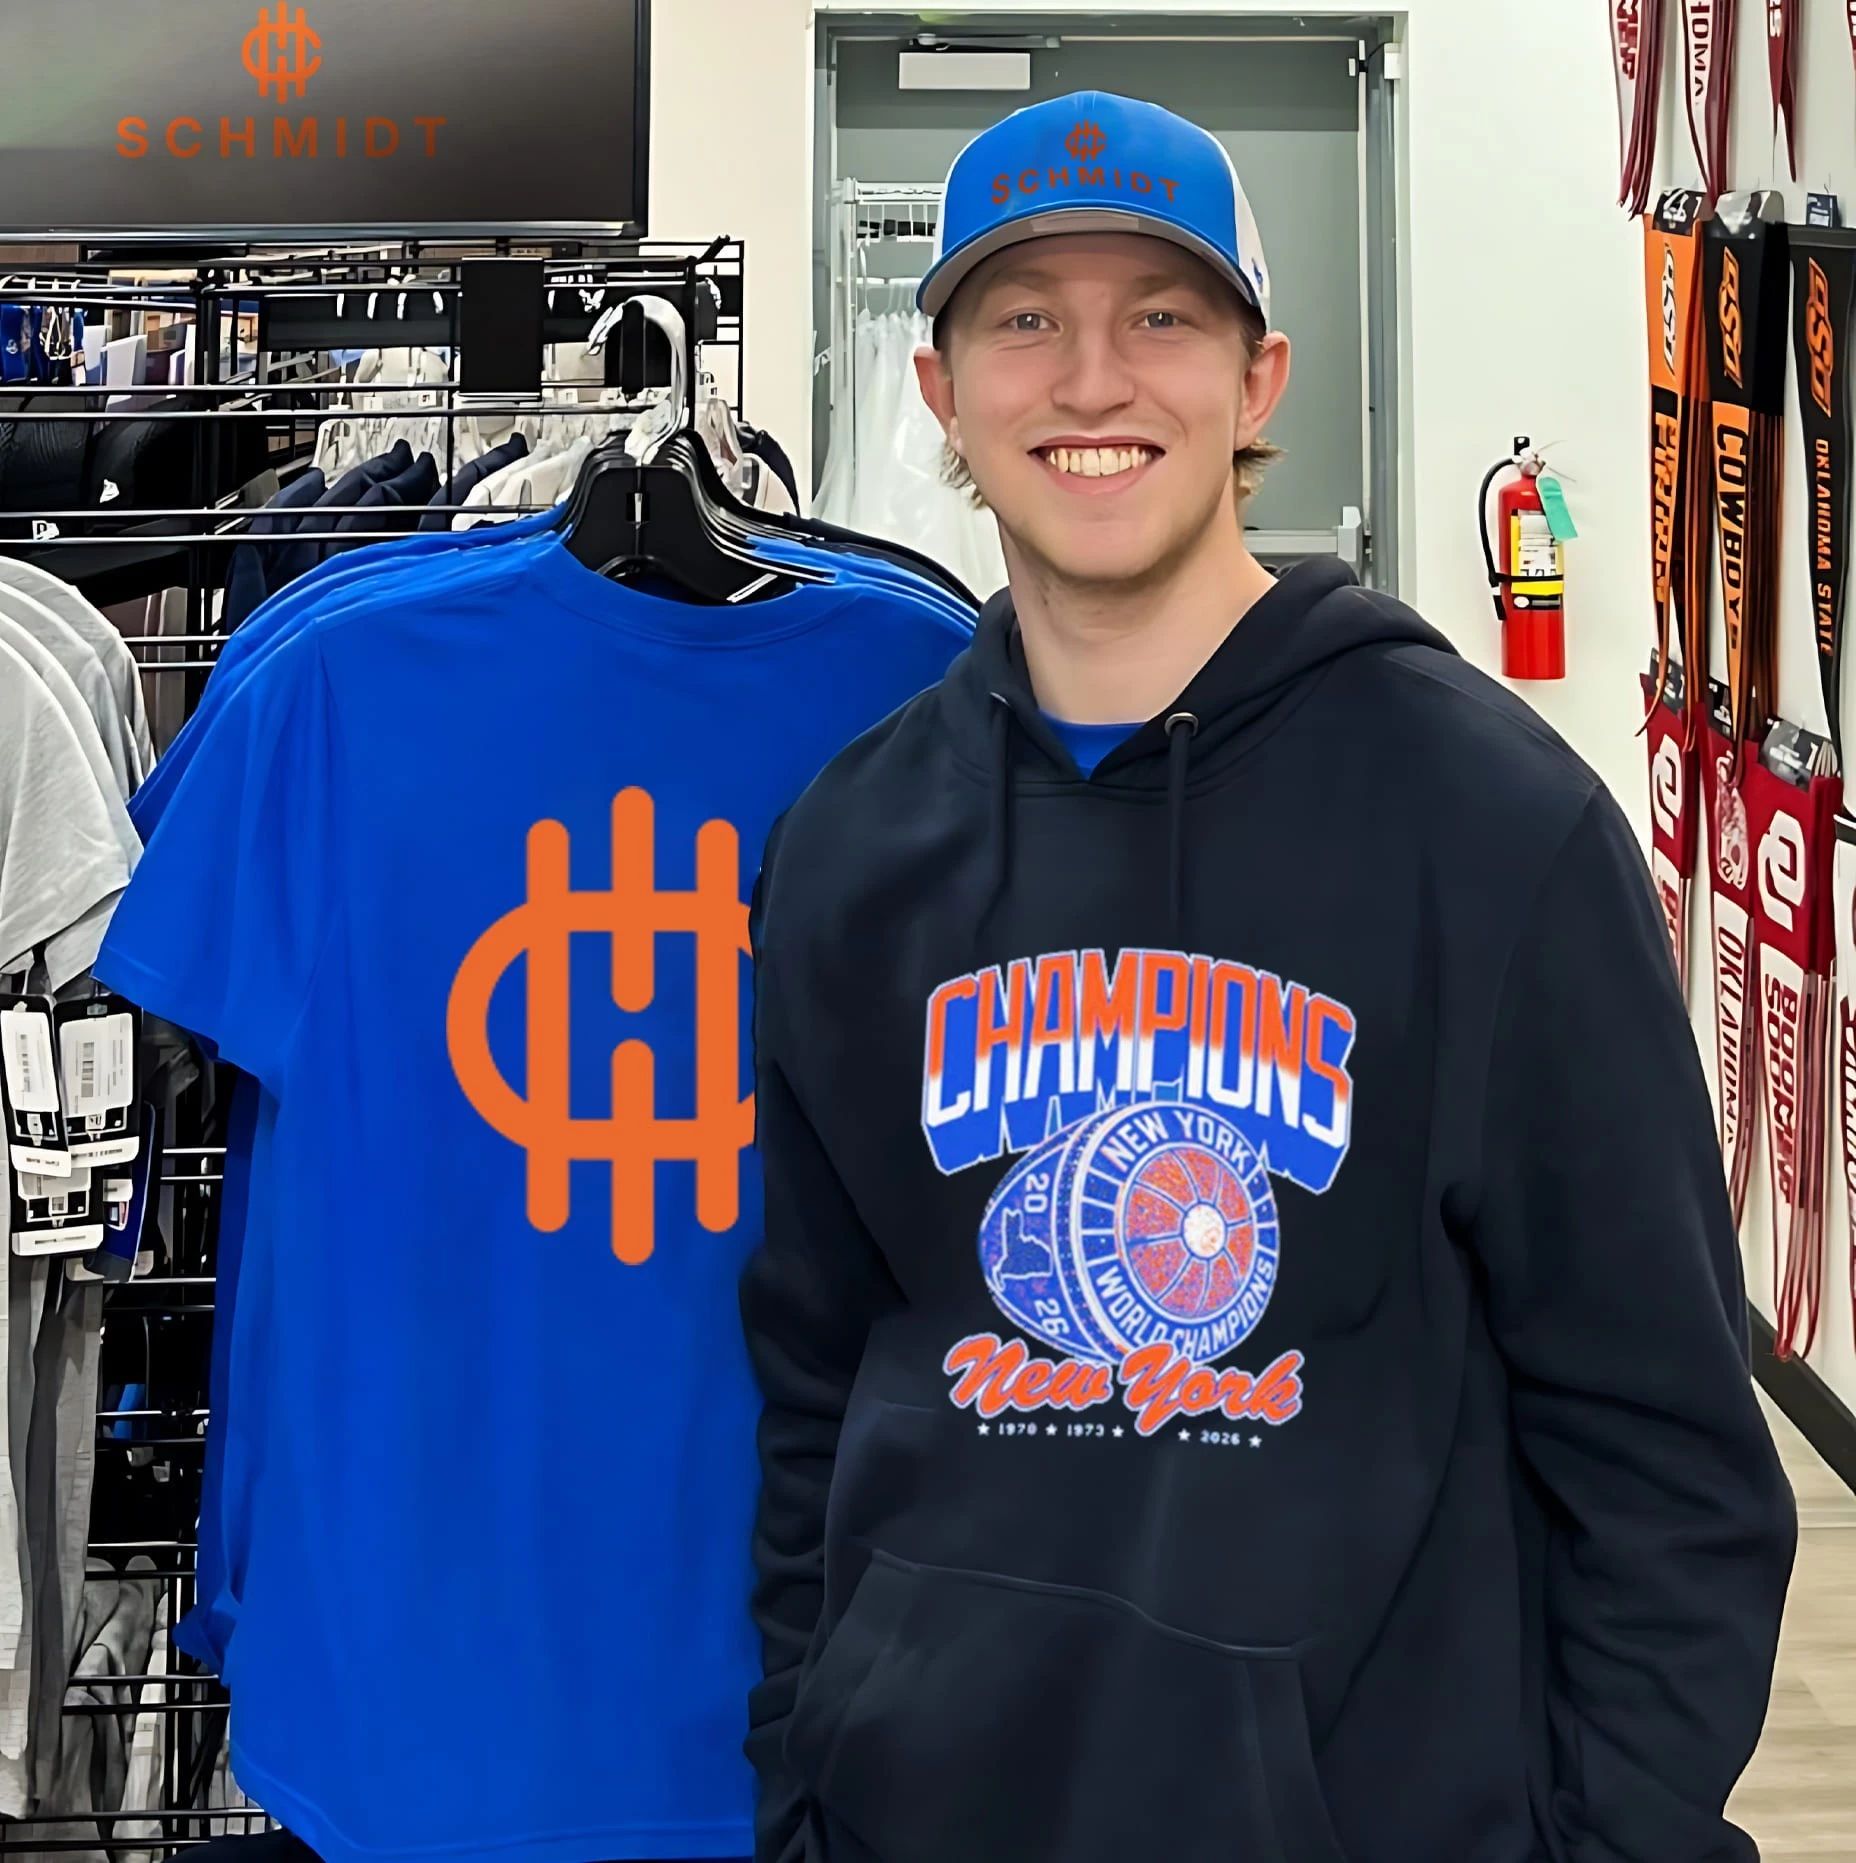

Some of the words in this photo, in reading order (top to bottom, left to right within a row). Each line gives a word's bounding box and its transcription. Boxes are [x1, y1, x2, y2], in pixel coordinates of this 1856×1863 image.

[115, 115, 449, 160] SCHMIDT
[991, 165, 1181, 205] SCHMIDT
[921, 946, 1356, 1172] CHAMPIONS
[1100, 1110, 1169, 1172] NEW
[1173, 1109, 1253, 1172] YORK
[1023, 1172, 1050, 1213] 20
[1034, 1299, 1070, 1337] 26
[1095, 1266, 1168, 1349] WORLD
[1173, 1257, 1275, 1358] CHAMPIONS
[943, 1332, 1113, 1416] New
[1117, 1340, 1305, 1437] York
[1200, 1429, 1241, 1446] 2026
